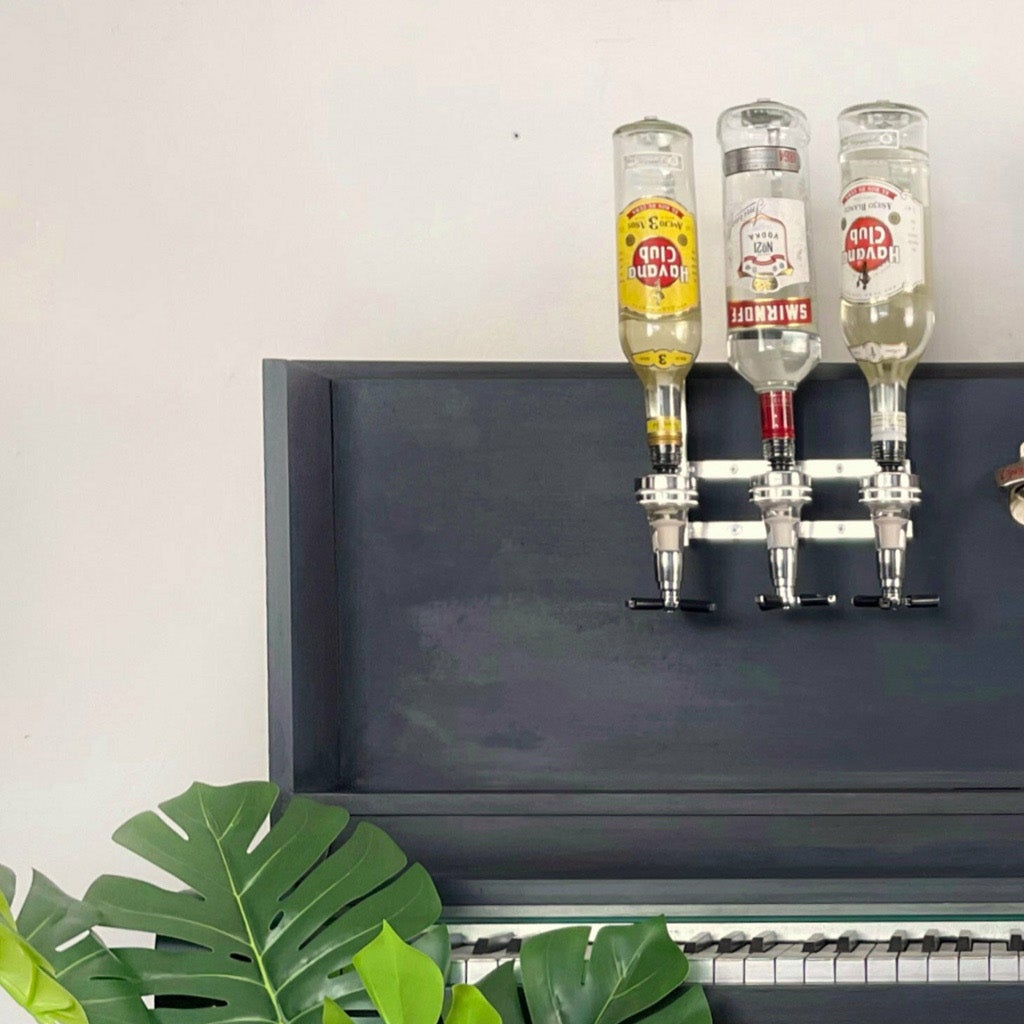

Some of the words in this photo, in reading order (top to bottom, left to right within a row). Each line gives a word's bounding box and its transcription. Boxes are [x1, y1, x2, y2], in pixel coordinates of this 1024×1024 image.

[648, 216, 658, 230] 3
[748, 232, 778, 240] VODKA
[849, 226, 886, 245] Club
[638, 246, 676, 263] Club
[627, 264, 688, 284] Havana
[731, 304, 807, 323] SMIRNOFF
[658, 354, 667, 365] 3
